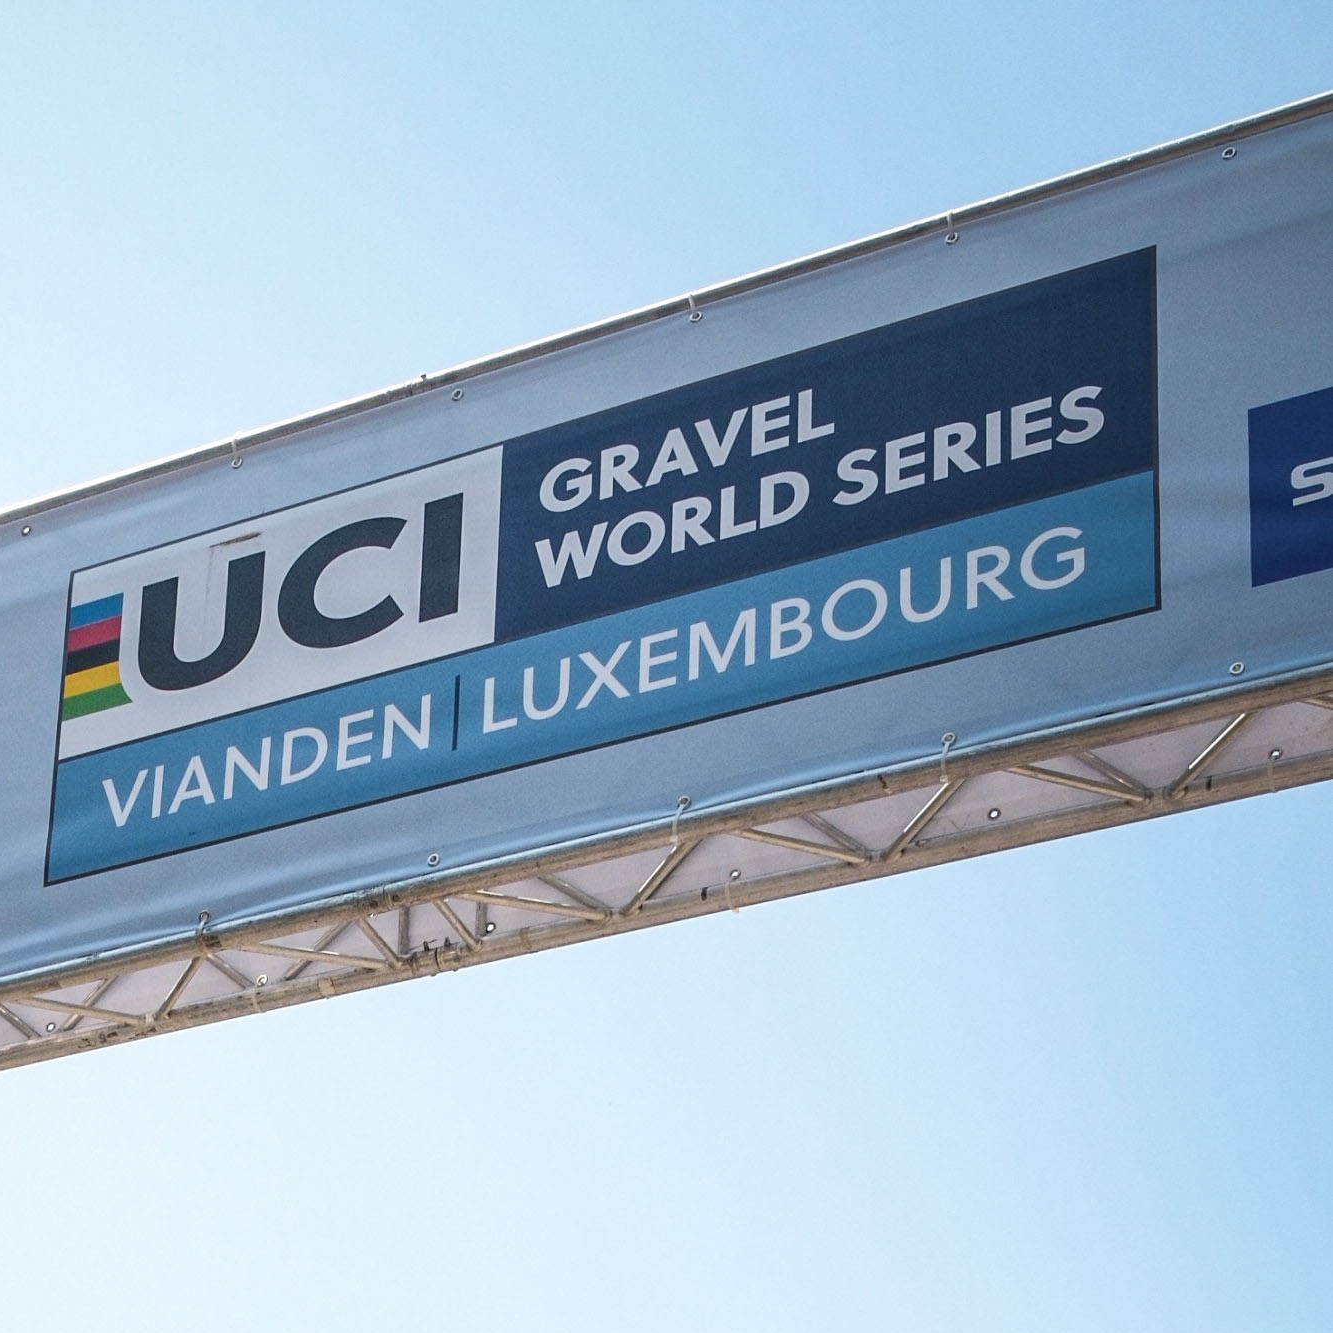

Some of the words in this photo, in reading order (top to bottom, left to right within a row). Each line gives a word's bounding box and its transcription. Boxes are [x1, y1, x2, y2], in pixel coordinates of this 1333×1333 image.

[533, 470, 813, 590] WORLD
[831, 383, 1106, 508] SERIES
[539, 388, 837, 515] GRAVEL
[101, 692, 433, 830] VIANDEN
[481, 523, 1088, 736] LUXEMBOURG
[136, 491, 464, 692] UCI
